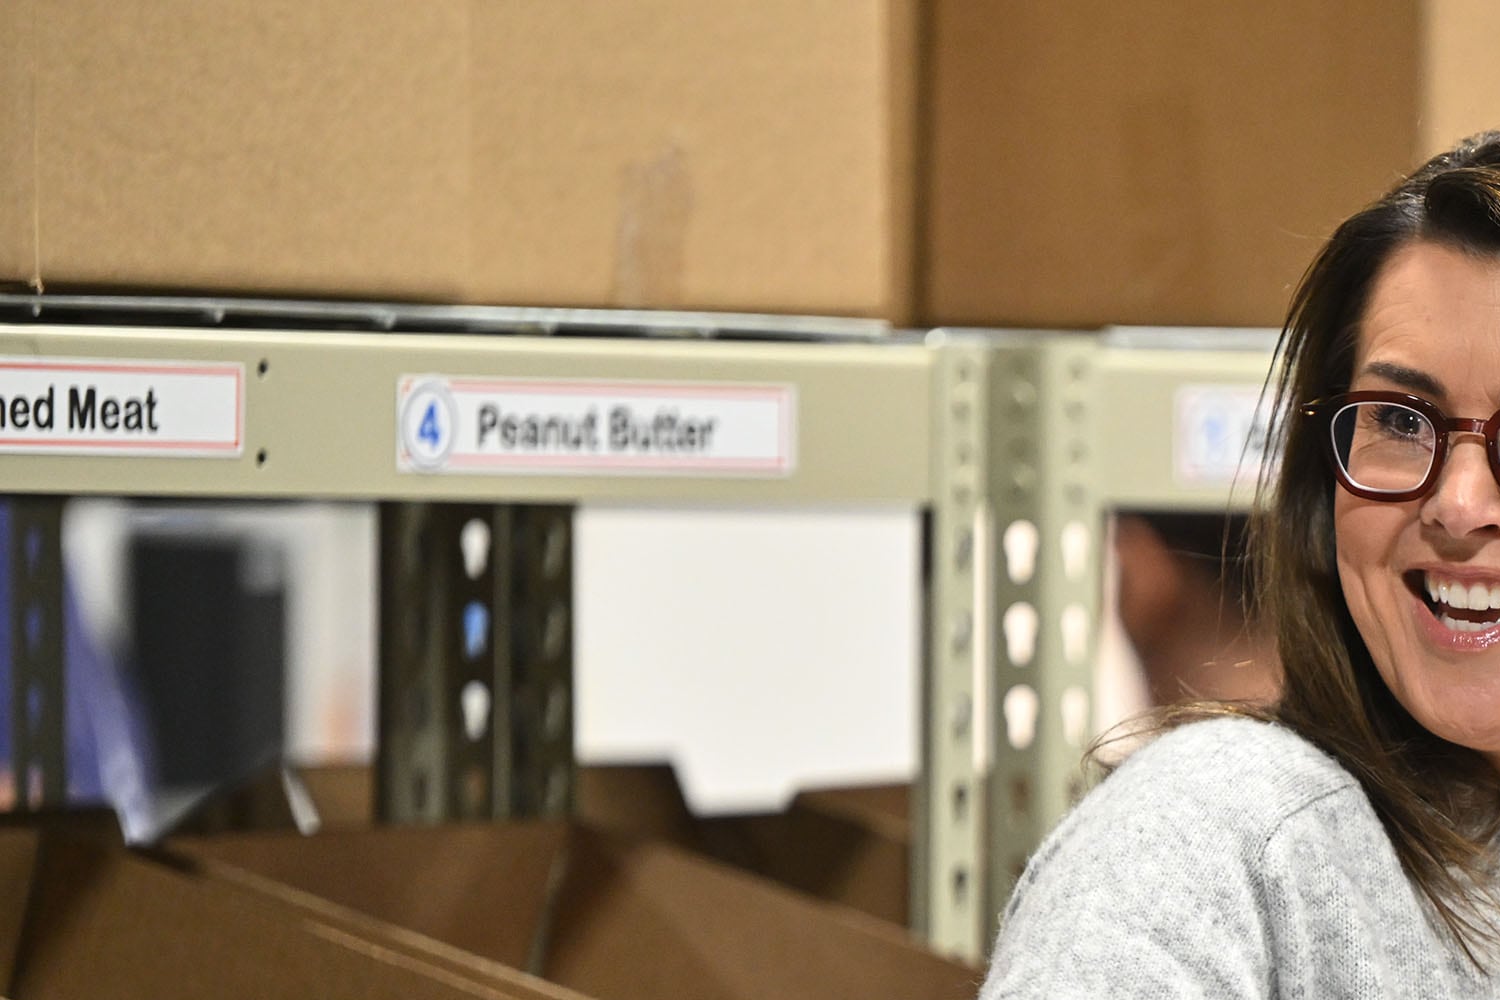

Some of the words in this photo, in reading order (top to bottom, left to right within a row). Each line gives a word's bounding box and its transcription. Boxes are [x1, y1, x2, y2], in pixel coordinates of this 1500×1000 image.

[68, 385, 158, 432] Meat
[417, 402, 442, 448] 4
[477, 402, 599, 451] Peanut
[608, 404, 717, 453] Butter
